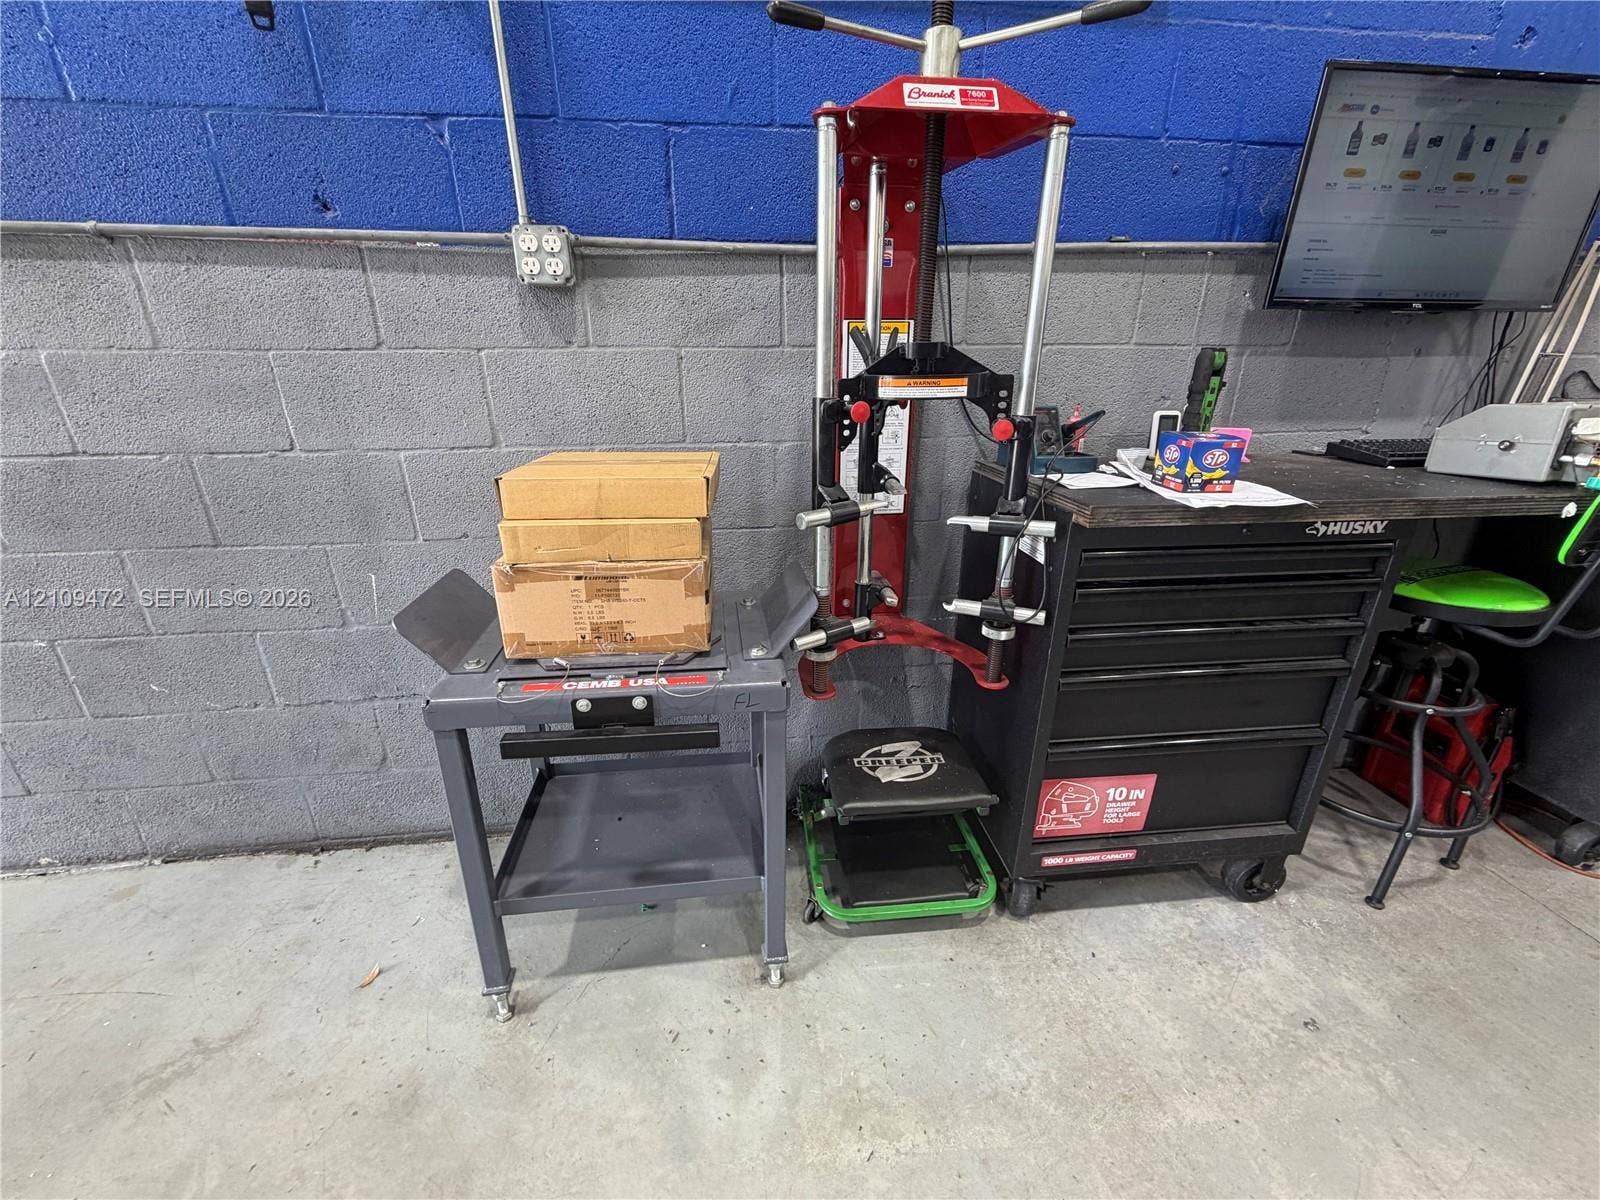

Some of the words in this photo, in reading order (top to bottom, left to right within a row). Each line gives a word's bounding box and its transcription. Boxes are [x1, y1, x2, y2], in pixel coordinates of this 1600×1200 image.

[908, 87, 956, 100] Branick
[966, 90, 987, 98] 7600
[1165, 446, 1179, 461] STP
[1206, 451, 1227, 466] STP
[1326, 520, 1389, 535] HUSKY
[562, 679, 621, 690] CEMB
[628, 677, 669, 687] USA
[856, 756, 944, 766] CREEPER
[1106, 787, 1128, 801] 10
[1129, 789, 1146, 800] IN
[1044, 857, 1064, 865] 1000
[1102, 852, 1134, 860] CAPACITY
